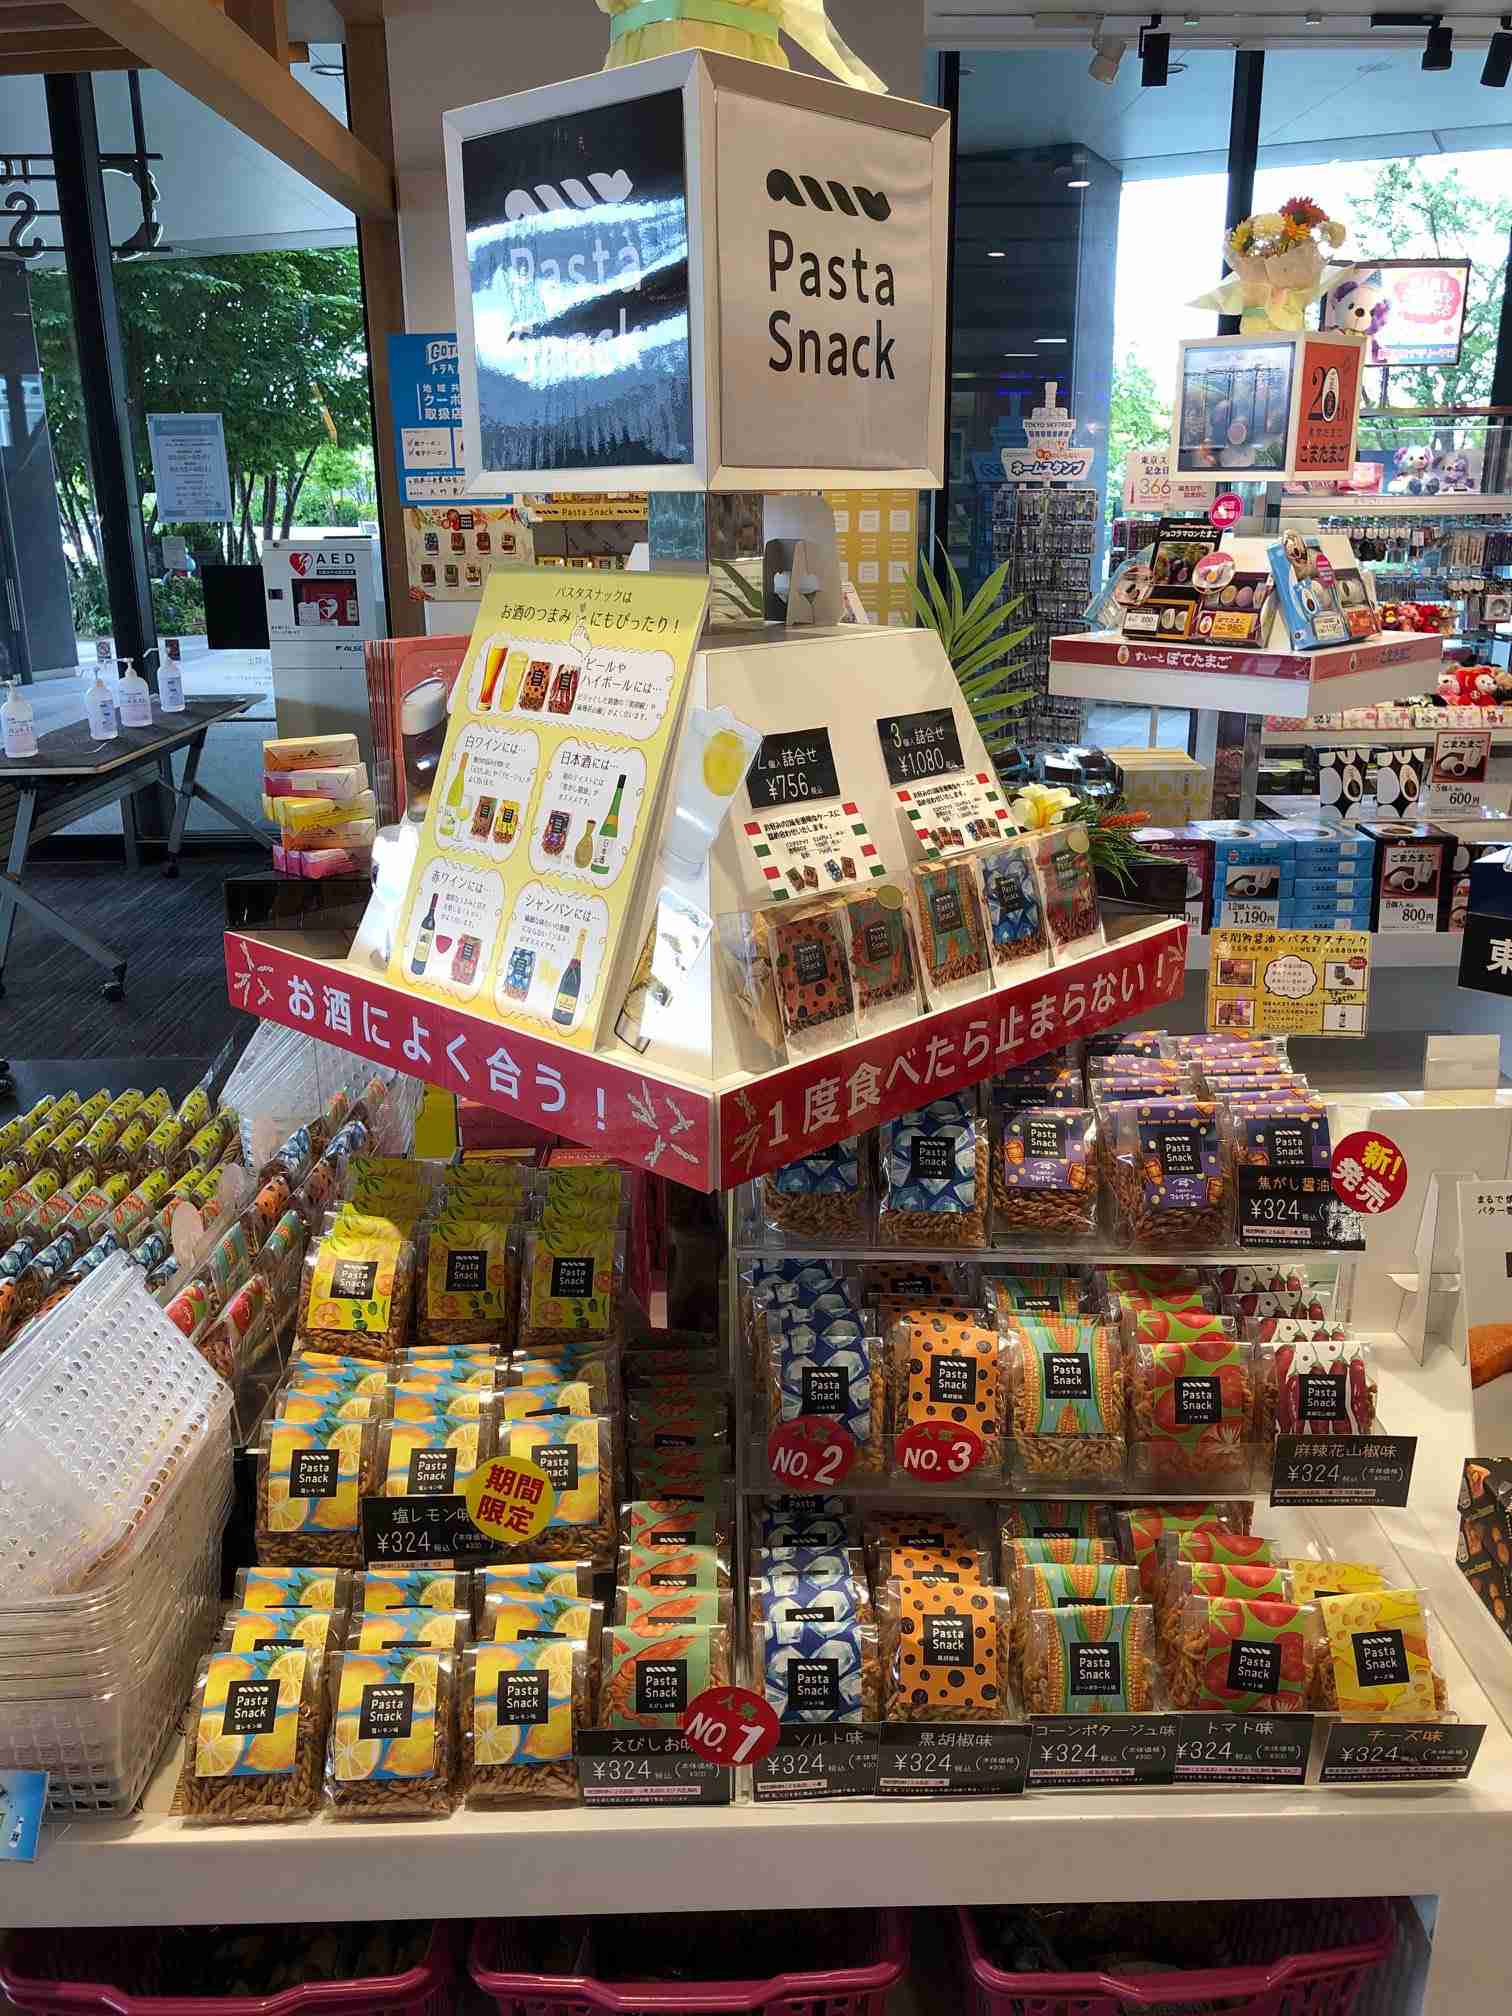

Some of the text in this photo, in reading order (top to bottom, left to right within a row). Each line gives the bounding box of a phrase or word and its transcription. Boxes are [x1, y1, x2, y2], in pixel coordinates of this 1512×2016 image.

[768, 229, 896, 307] Pasta
[768, 309, 896, 380] Snack
[1011, 460, 1085, 475] ネームスタンプ
[316, 553, 356, 564] AED
[555, 586, 632, 604] パスタスナックは
[501, 603, 572, 624] お酒のつまみ
[584, 657, 628, 674] ビールや
[898, 747, 945, 777] ¥1,080
[766, 772, 810, 801] ¥756
[1232, 909, 1276, 924] 1,190円
[1402, 908, 1434, 922] 800円
[1031, 1129, 1057, 1138] Pasta
[1031, 1138, 1057, 1147] Snack
[1275, 1137, 1304, 1147] Pasta
[919, 1147, 948, 1158] Pasta
[1166, 1144, 1191, 1153] Pasta
[1275, 1147, 1305, 1157] Snack
[919, 1157, 948, 1166] Snack
[1166, 1153, 1193, 1162] Snack
[1332, 1157, 1392, 1213] 発売
[1250, 1198, 1301, 1222] ¥324
[455, 1262, 479, 1271] Pasta
[342, 1270, 368, 1279] Pasta
[454, 1271, 479, 1280] Snack
[561, 1268, 586, 1278] Pasta
[340, 1279, 367, 1288] Snack
[559, 1277, 584, 1286] Snack
[938, 1368, 969, 1380] Pasta
[1053, 1365, 1083, 1376] Pasta
[810, 1380, 840, 1391] Pasta
[938, 1379, 969, 1390] Snack
[1052, 1375, 1083, 1385] Snack
[810, 1391, 841, 1401] Snack
[1182, 1389, 1213, 1400] Pasta
[1307, 1388, 1337, 1398] Pasta
[1182, 1400, 1213, 1411] Snack
[1307, 1398, 1337, 1408] Snack
[1295, 1443, 1400, 1458] 麻辣花山椒味
[300, 1462, 330, 1473] Pasta
[418, 1461, 447, 1471] Pasta
[539, 1457, 569, 1467] Pasta
[299, 1473, 329, 1483] Snack
[417, 1471, 447, 1482] Snack
[1287, 1463, 1340, 1483] ¥324
[484, 1463, 545, 1506] 期間
[476, 1493, 536, 1536] 限定
[376, 1530, 431, 1553] ¥324
[932, 1627, 964, 1639] Pasta
[932, 1639, 965, 1651] Snack
[1364, 1647, 1396, 1658] Pasta
[1079, 1657, 1111, 1668] Pasta
[1239, 1656, 1271, 1668] Pasta
[1365, 1658, 1398, 1670] Snack
[797, 1673, 830, 1684] Pasta
[1079, 1669, 1111, 1680] Snack
[1237, 1666, 1270, 1680] Snack
[646, 1676, 678, 1686] Pasta
[507, 1685, 539, 1697] Pasta
[646, 1687, 678, 1698] Snack
[797, 1685, 830, 1697] Snack
[236, 1695, 269, 1707] Pasta
[370, 1699, 404, 1710] Pasta
[506, 1697, 539, 1709] Snack
[234, 1706, 267, 1719] Snack
[369, 1711, 403, 1722] Snack
[1036, 1724, 1176, 1738] コーンポタージュ味
[1208, 1721, 1274, 1735] トマト味
[685, 1711, 766, 1763] NO.1
[794, 1729, 864, 1748] ソルト味
[918, 1731, 993, 1747] 黒胡椒味
[1367, 1729, 1444, 1744] チーズ味
[1040, 1742, 1098, 1763] ¥324
[1176, 1741, 1233, 1760] ¥324
[1340, 1745, 1400, 1763] ¥324
[767, 1752, 825, 1775] ¥324
[895, 1752, 953, 1773] ¥324
[592, 1759, 651, 1780] ¥324
